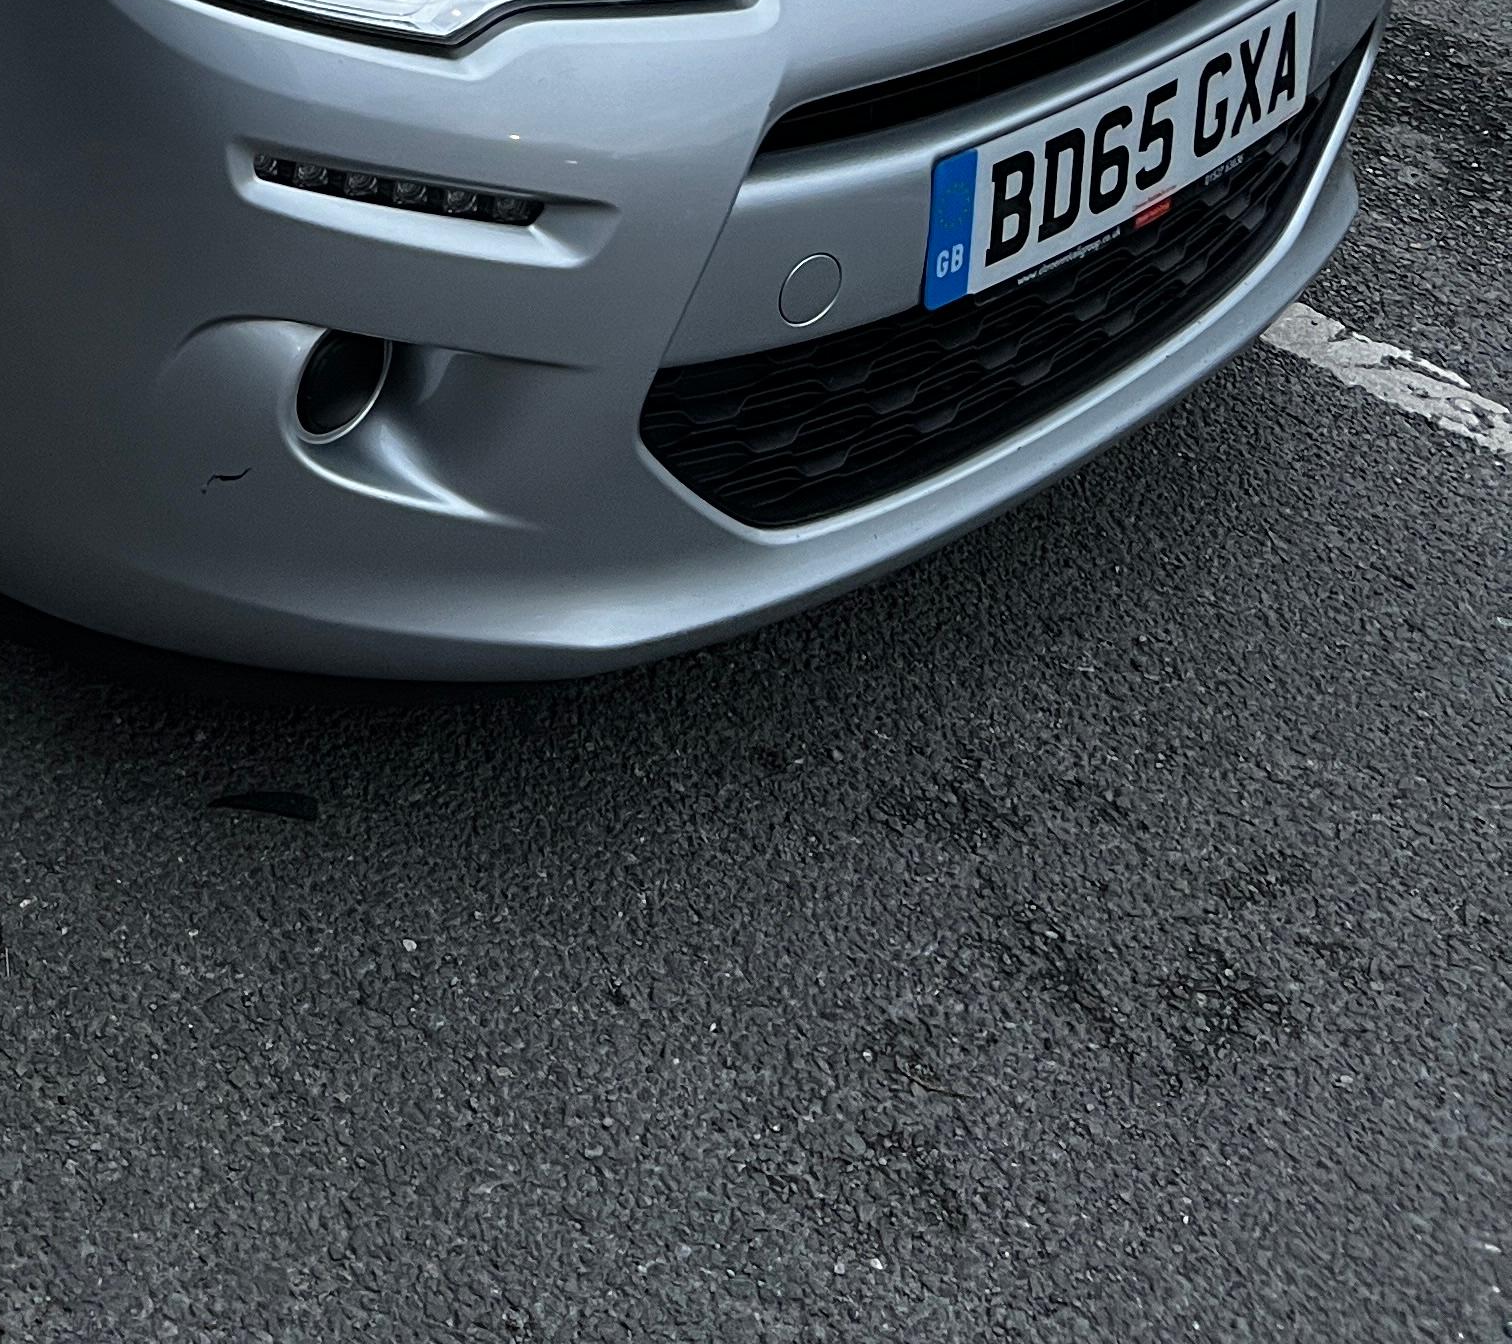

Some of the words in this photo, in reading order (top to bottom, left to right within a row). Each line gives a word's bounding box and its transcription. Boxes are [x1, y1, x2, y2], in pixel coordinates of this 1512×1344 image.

[984, 78, 1179, 268] BD65
[1192, 10, 1298, 159] GXA
[935, 243, 965, 279] GB
